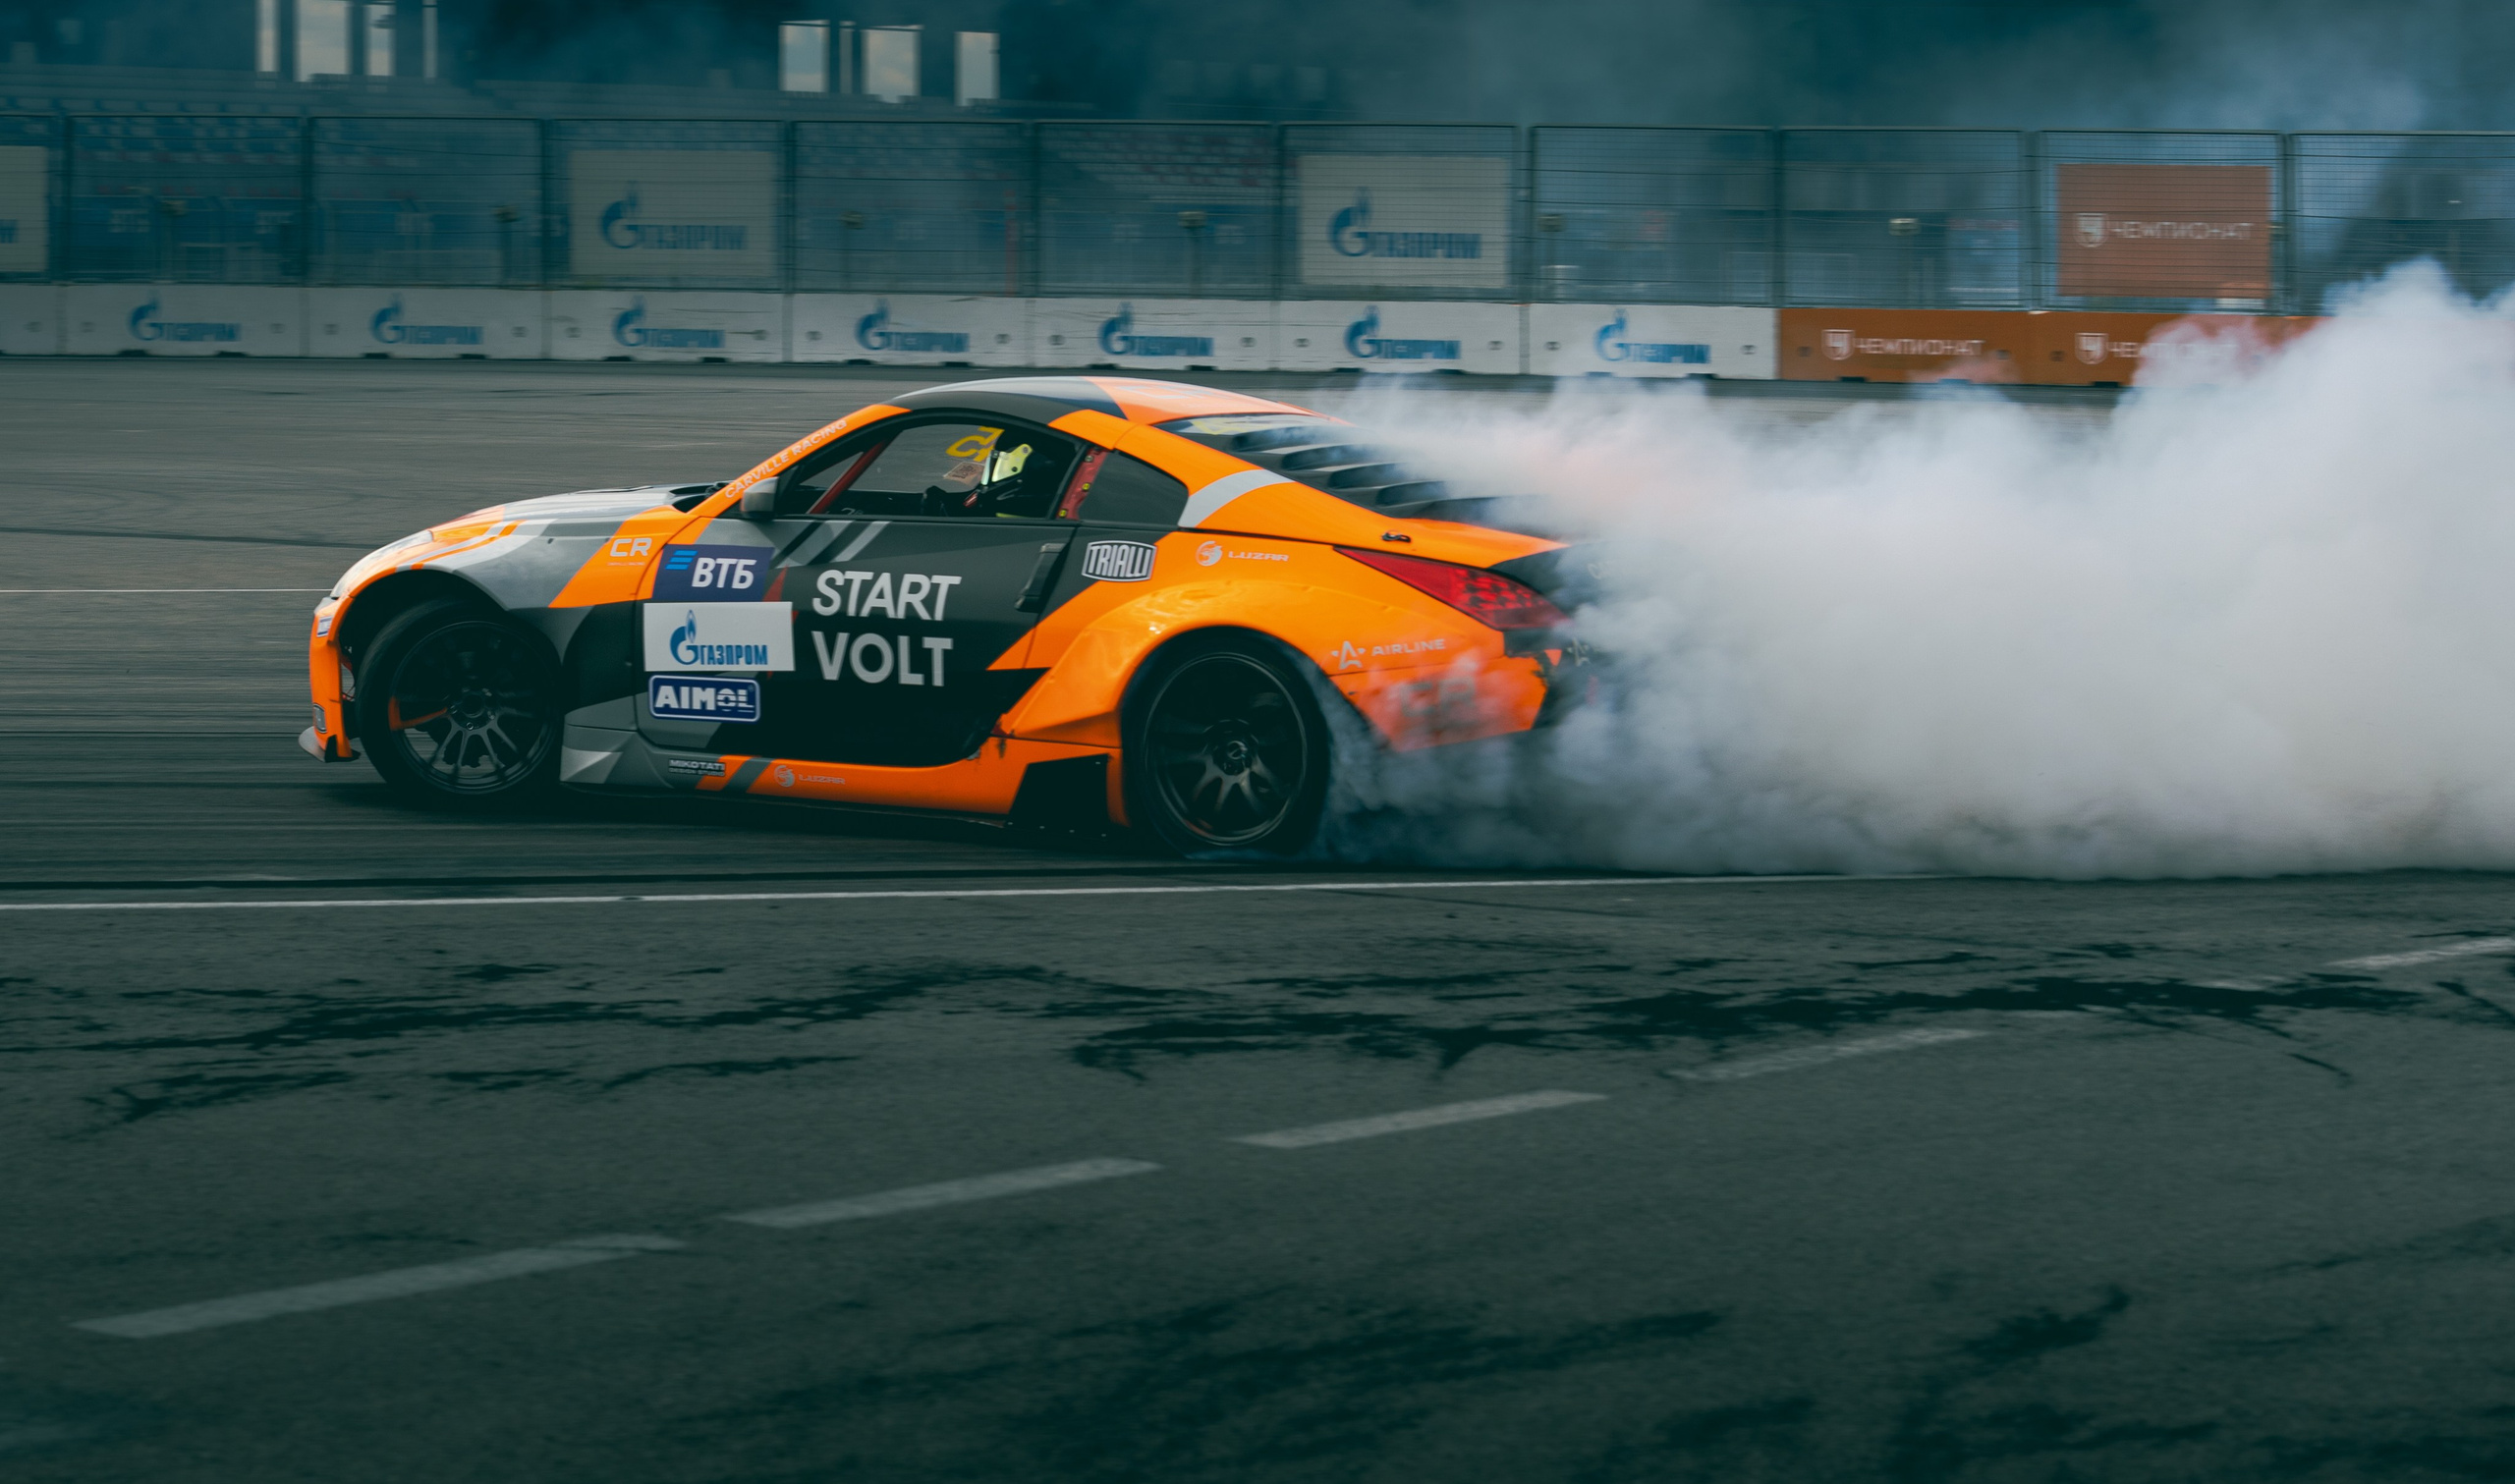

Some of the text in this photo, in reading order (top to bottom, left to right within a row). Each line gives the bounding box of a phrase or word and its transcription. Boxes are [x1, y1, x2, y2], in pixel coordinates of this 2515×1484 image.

[725, 419, 848, 498] CARVILLE RACING
[609, 537, 652, 557] CR
[1228, 551, 1290, 562] LUZAR
[692, 557, 757, 589] ВТБ
[811, 569, 963, 622] START
[700, 644, 768, 666] ГАЗПРОМ
[810, 631, 954, 687] VOLT
[1371, 638, 1445, 656] AIRLINE
[654, 685, 755, 714] AIMOL
